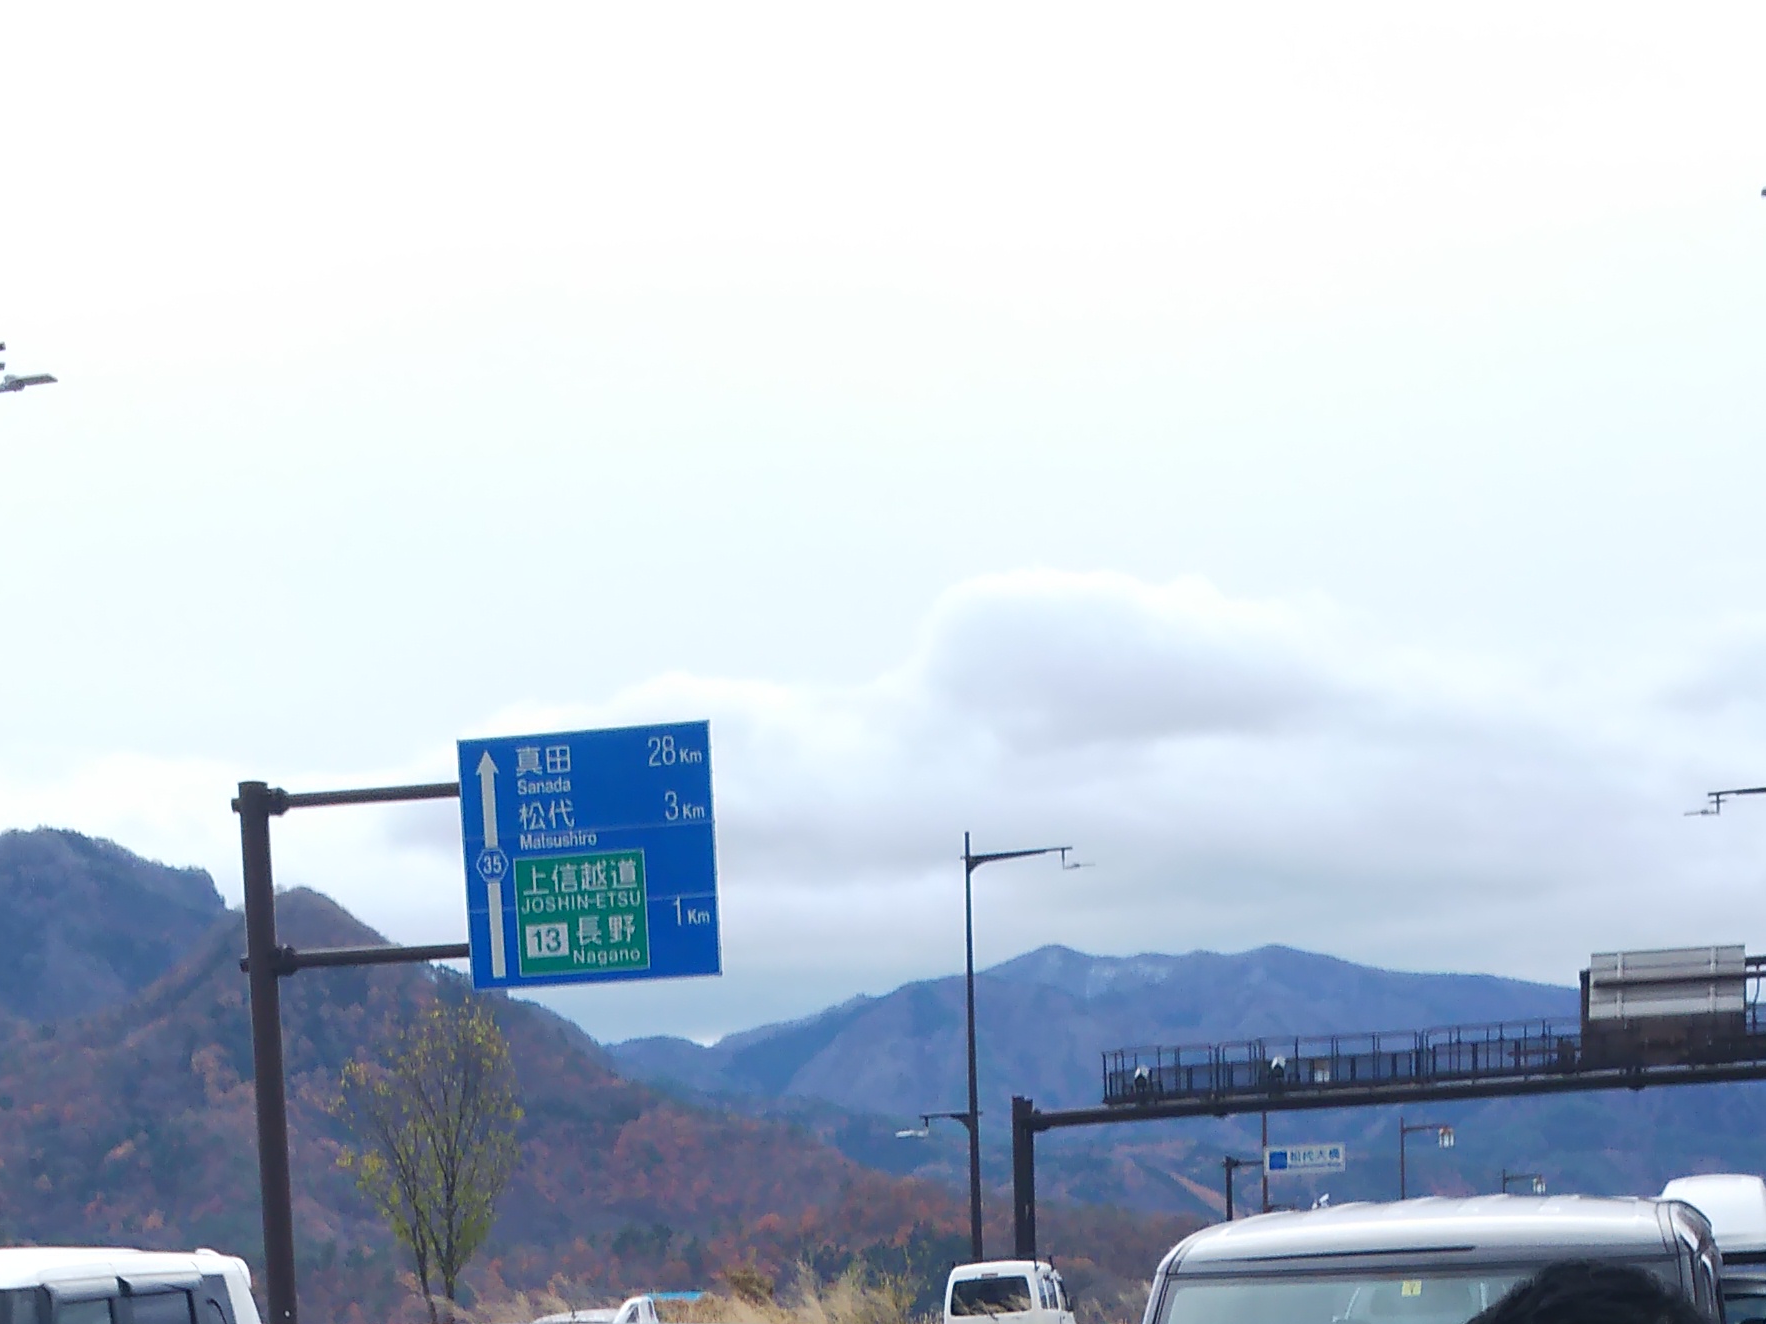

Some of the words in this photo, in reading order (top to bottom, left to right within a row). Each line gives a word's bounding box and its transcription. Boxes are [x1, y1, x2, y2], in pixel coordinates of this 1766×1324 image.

[516, 744, 571, 777] 真田
[647, 735, 676, 767] 28
[517, 776, 571, 796] Sanada
[519, 799, 575, 831] 松代
[664, 790, 679, 820] 3
[520, 830, 598, 851] Matsushiro
[483, 855, 502, 875] 35
[523, 857, 637, 896] 上信越道
[521, 889, 641, 914] JOSHIN-ETSU
[673, 895, 682, 926] 1
[534, 927, 561, 953] 13
[576, 913, 636, 945] 長野
[573, 946, 641, 967] Nagano
